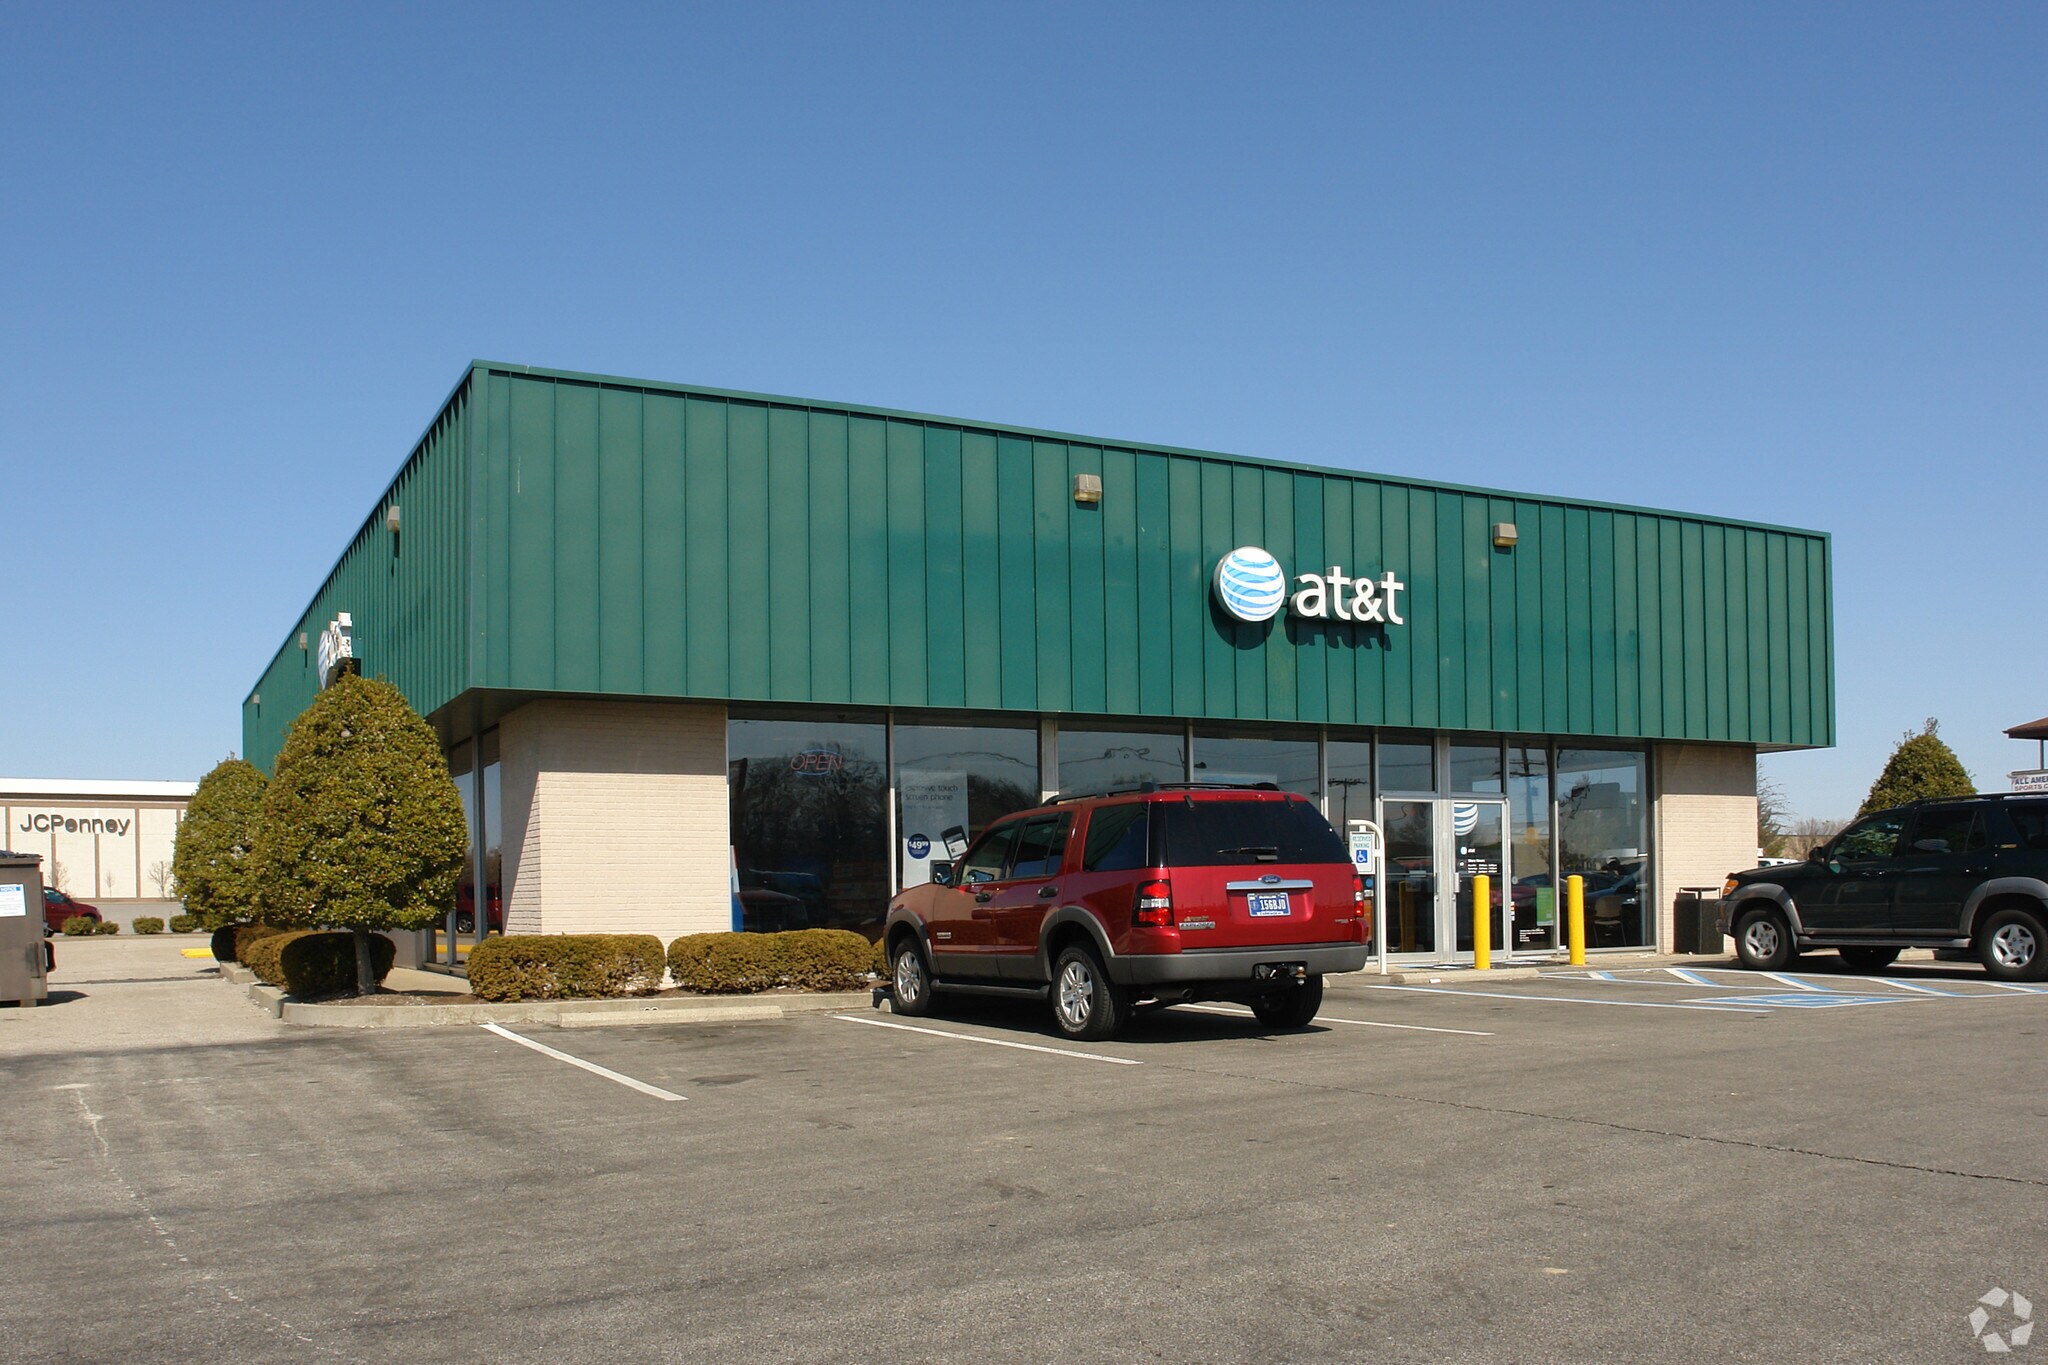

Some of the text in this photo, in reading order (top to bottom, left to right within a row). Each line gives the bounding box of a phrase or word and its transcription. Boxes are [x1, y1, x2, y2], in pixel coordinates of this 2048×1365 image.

[1291, 565, 1404, 625] at&t
[790, 754, 843, 770] OPEN
[2031, 775, 2048, 783] AME
[938, 784, 959, 792] touch
[2014, 783, 2042, 791] SPORTS
[930, 793, 953, 802] phone
[20, 813, 131, 836] JCPenney
